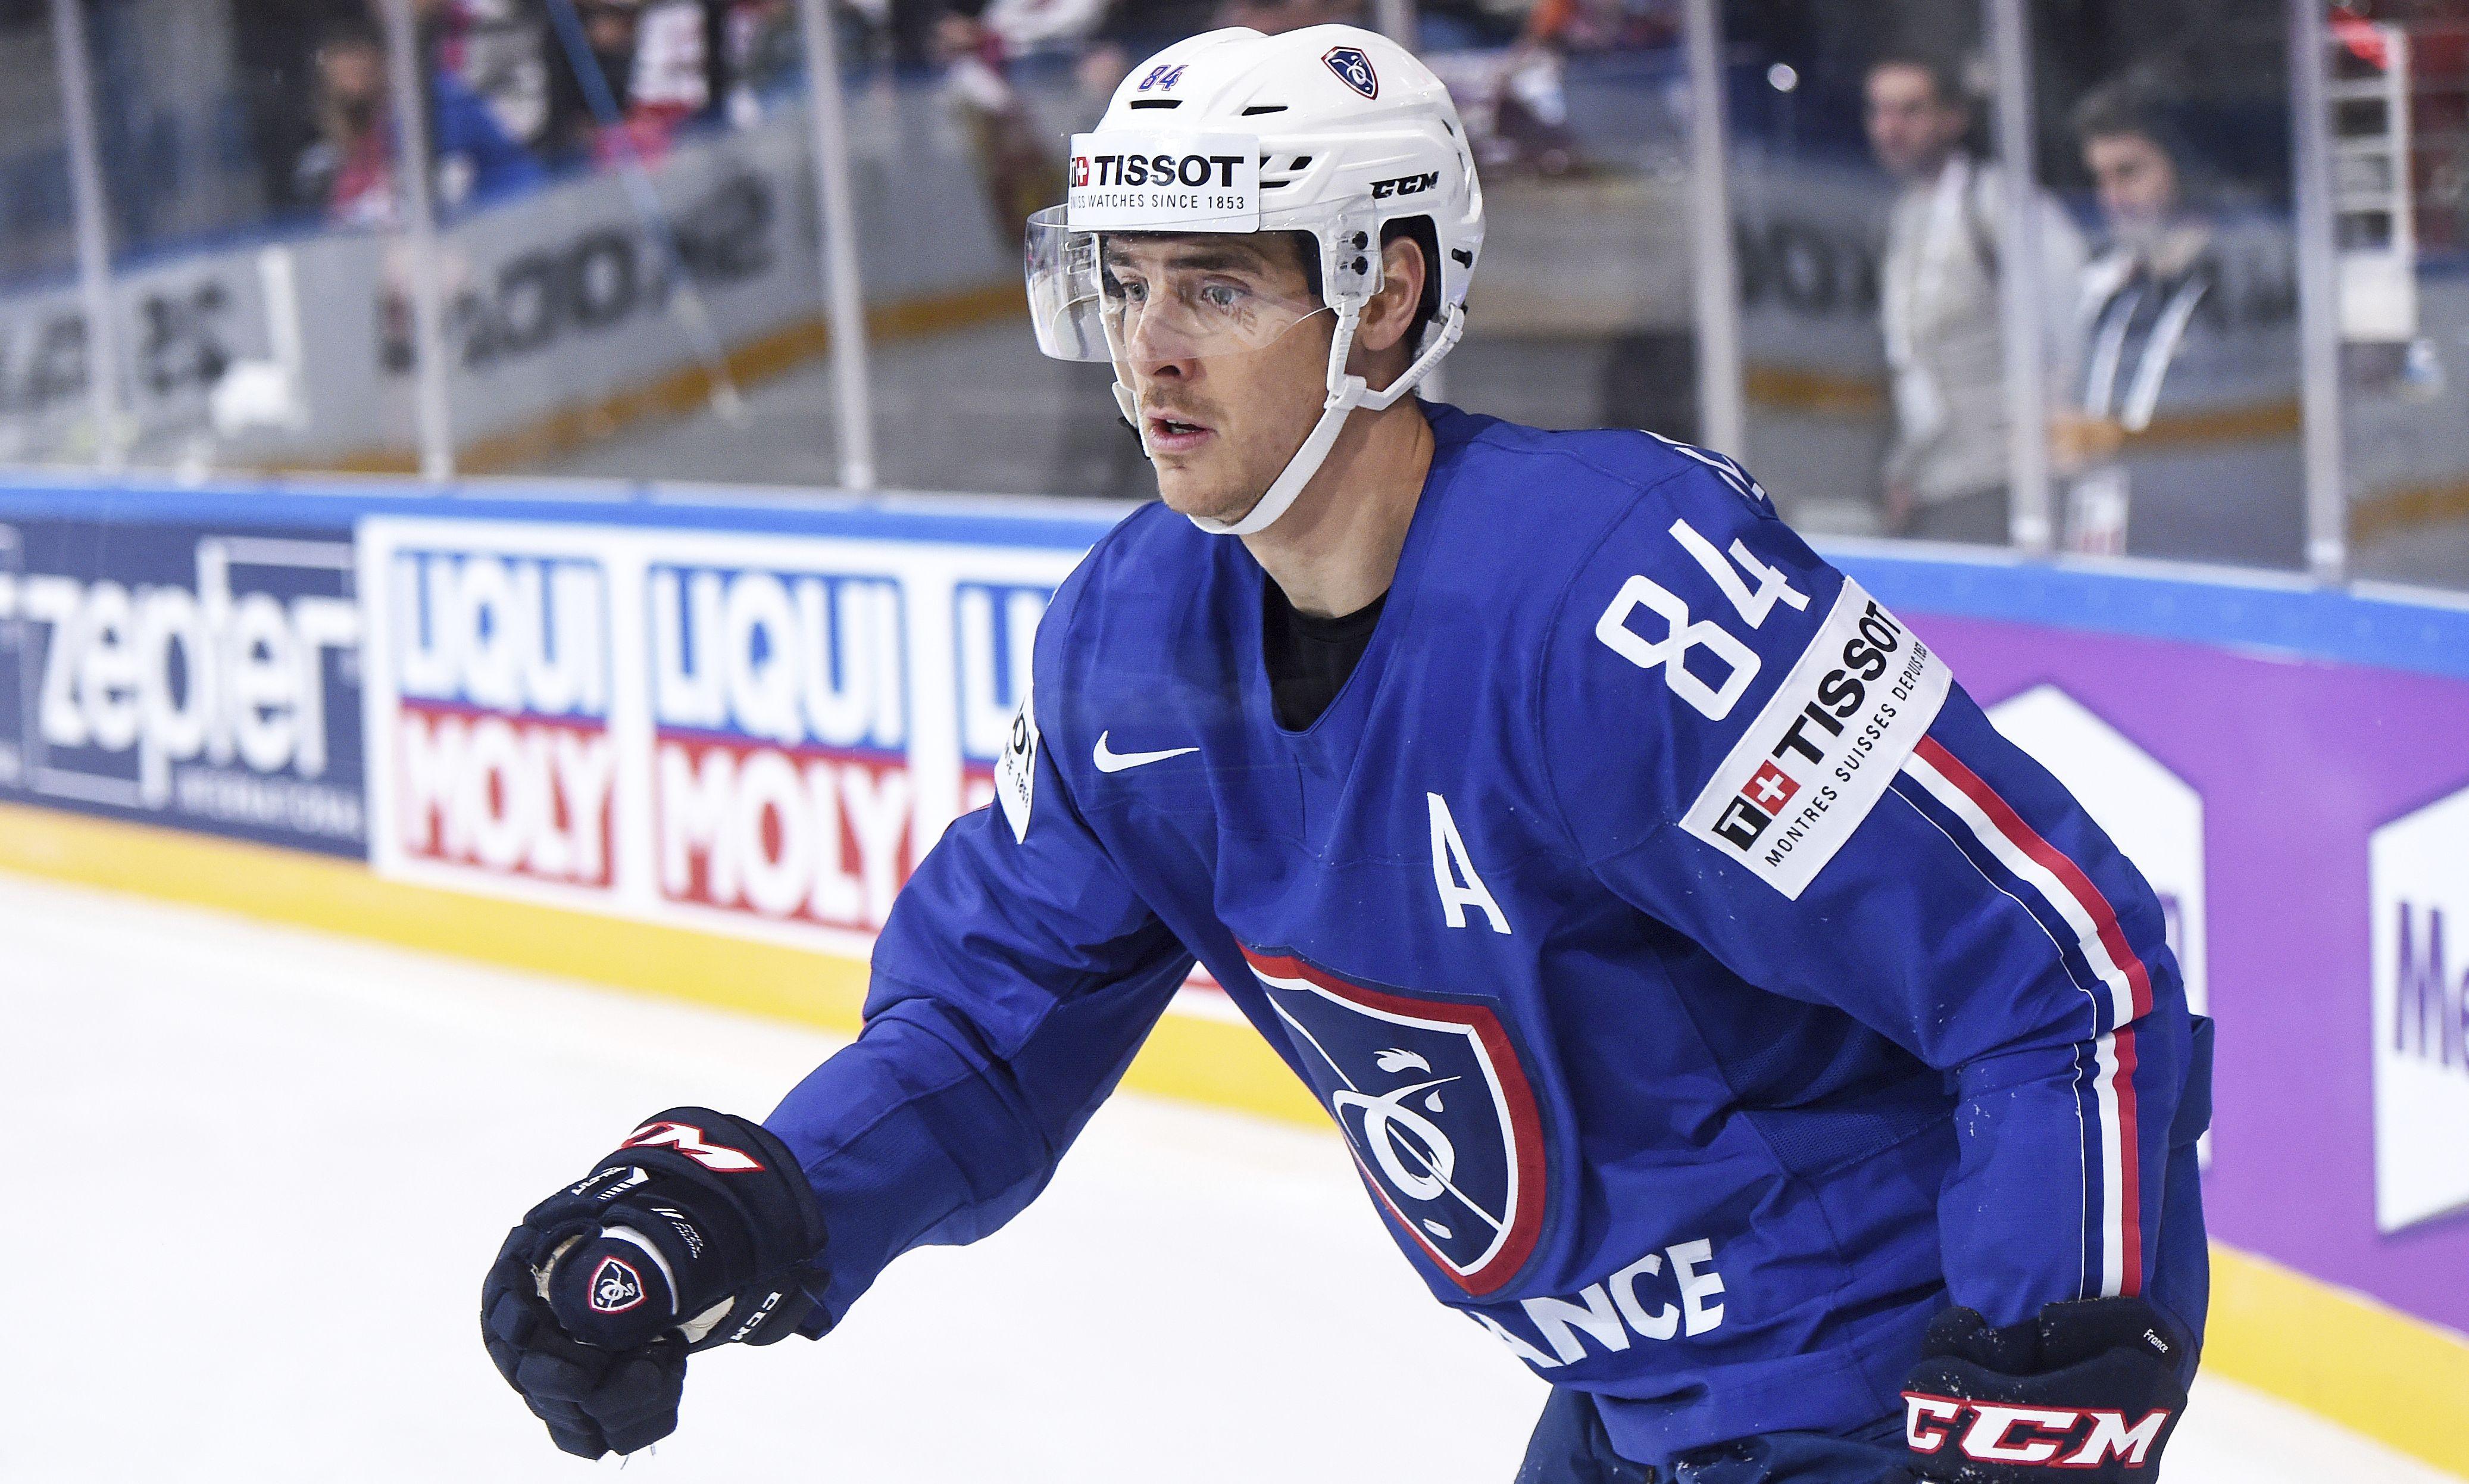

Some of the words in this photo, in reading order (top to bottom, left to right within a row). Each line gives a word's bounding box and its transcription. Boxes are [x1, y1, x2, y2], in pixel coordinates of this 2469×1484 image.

[1137, 64, 1189, 92] 84
[1088, 194, 1144, 208] WATCHES
[1152, 194, 1198, 208] SINCE
[1208, 196, 1244, 209] 1853
[1095, 154, 1244, 187] TISSOT
[1369, 170, 1439, 199] CCM
[398, 561, 604, 713] LIQUI
[656, 568, 904, 749] LIQUI
[1596, 518, 1811, 721] 84
[1772, 600, 1901, 765] TISSOT
[406, 718, 616, 880] MOLY
[1765, 786, 1837, 867] MONTRES
[1835, 704, 1897, 782] SUISSES
[1892, 656, 1923, 701] DEPUIS
[661, 745, 911, 930] MOLY
[1427, 792, 1511, 934] A
[730, 1292, 782, 1341] CCM
[2143, 1329, 2168, 1354] France
[1901, 1392, 2171, 1469] CCM
